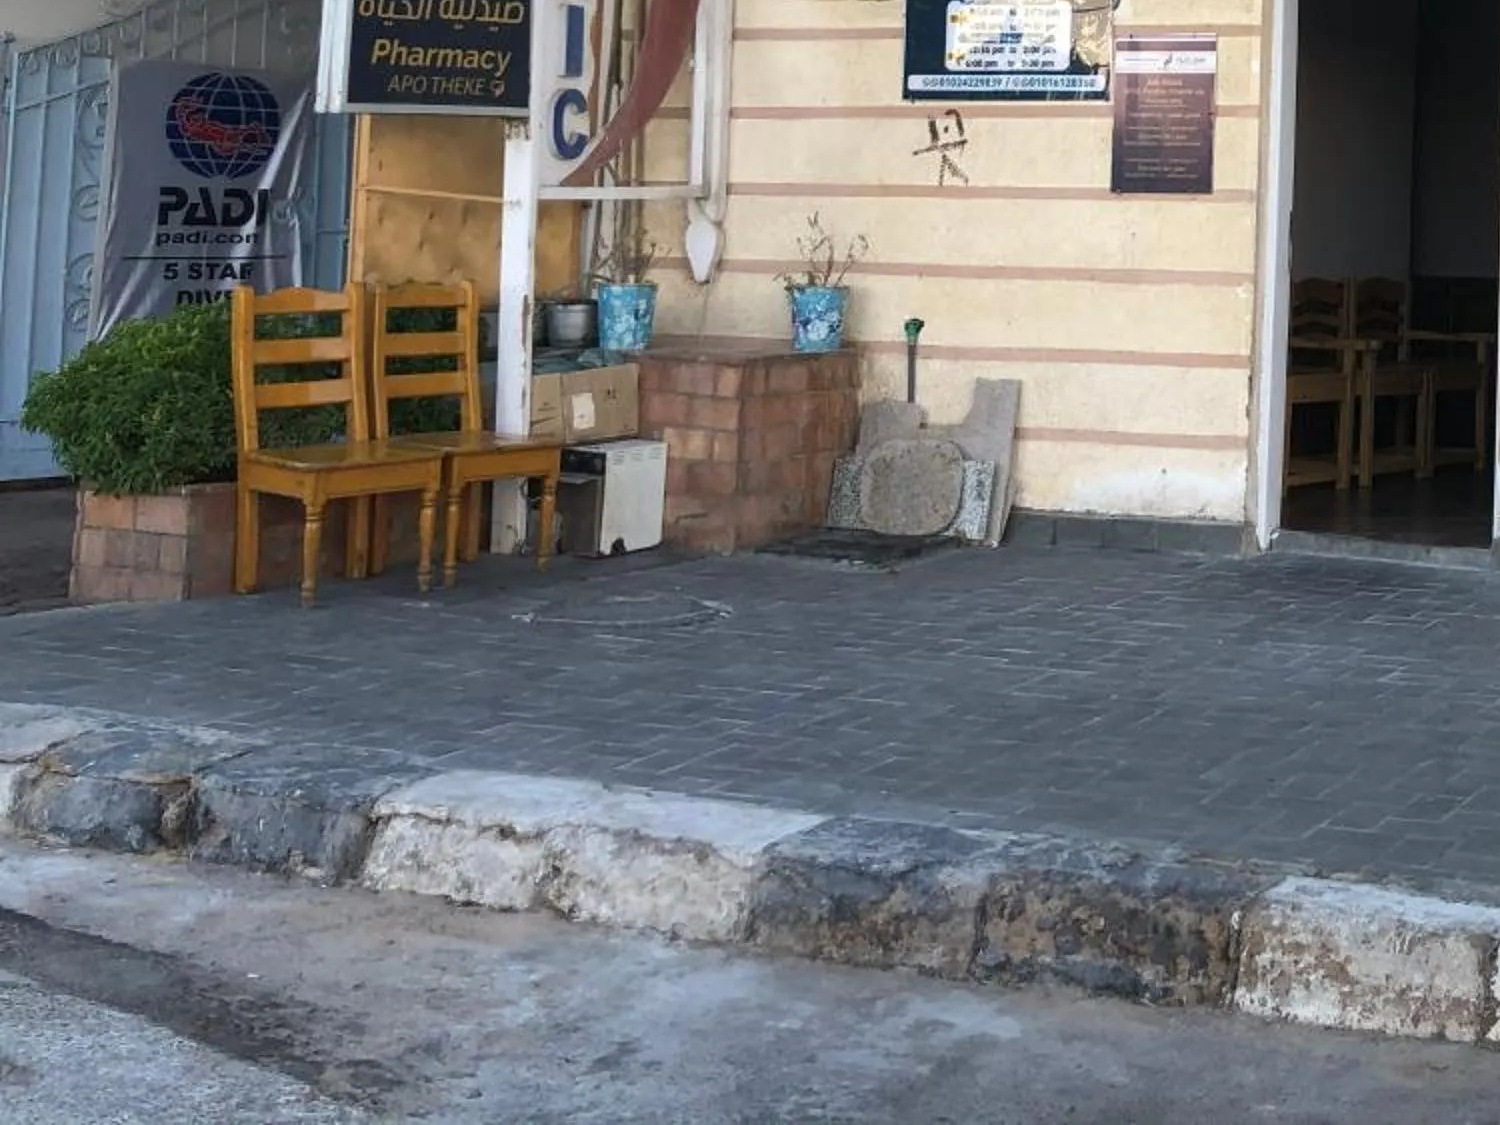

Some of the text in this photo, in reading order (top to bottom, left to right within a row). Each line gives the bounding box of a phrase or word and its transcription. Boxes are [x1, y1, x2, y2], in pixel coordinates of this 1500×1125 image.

[371, 38, 512, 78] Pharmacy
[158, 187, 269, 226] PADI
[164, 263, 179, 280] 5
